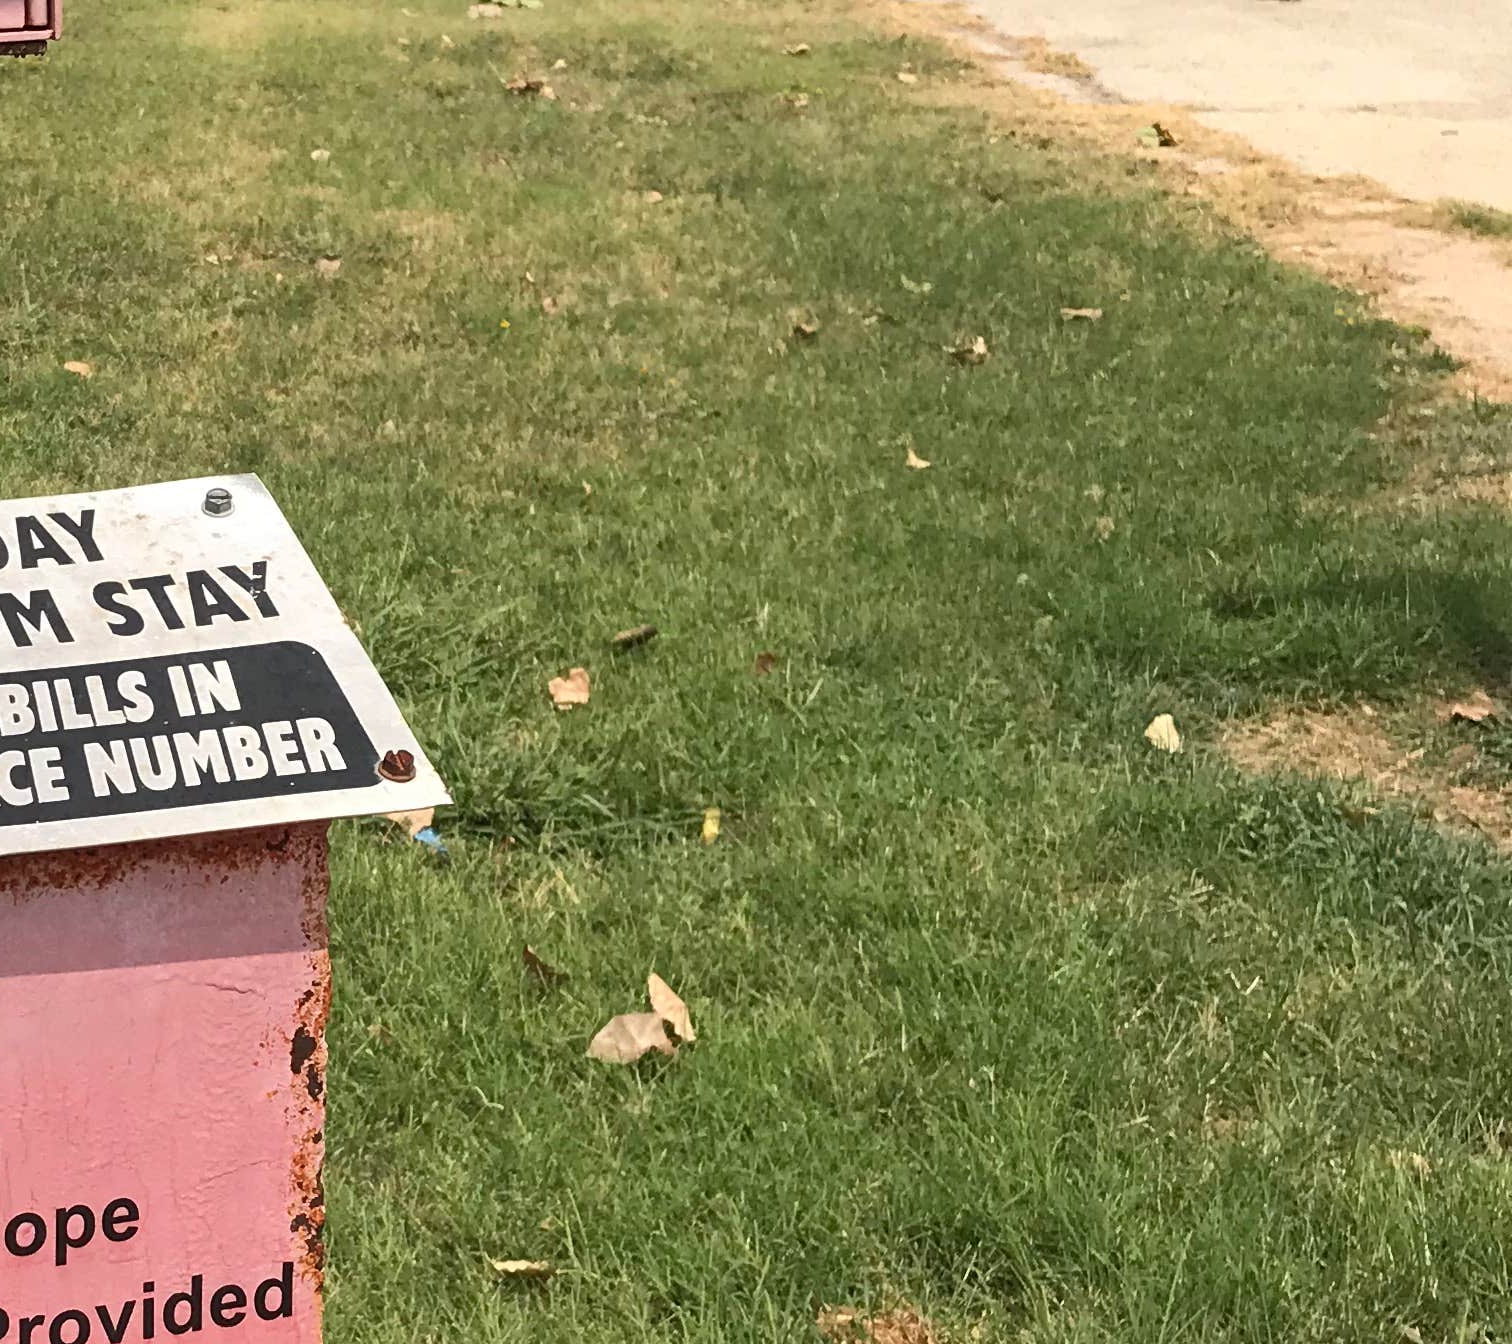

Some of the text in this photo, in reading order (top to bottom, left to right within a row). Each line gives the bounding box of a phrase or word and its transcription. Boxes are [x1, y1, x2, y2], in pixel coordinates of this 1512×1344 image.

[93, 562, 281, 637] STAY
[167, 660, 240, 718] IN
[83, 717, 347, 797] NUMBER
